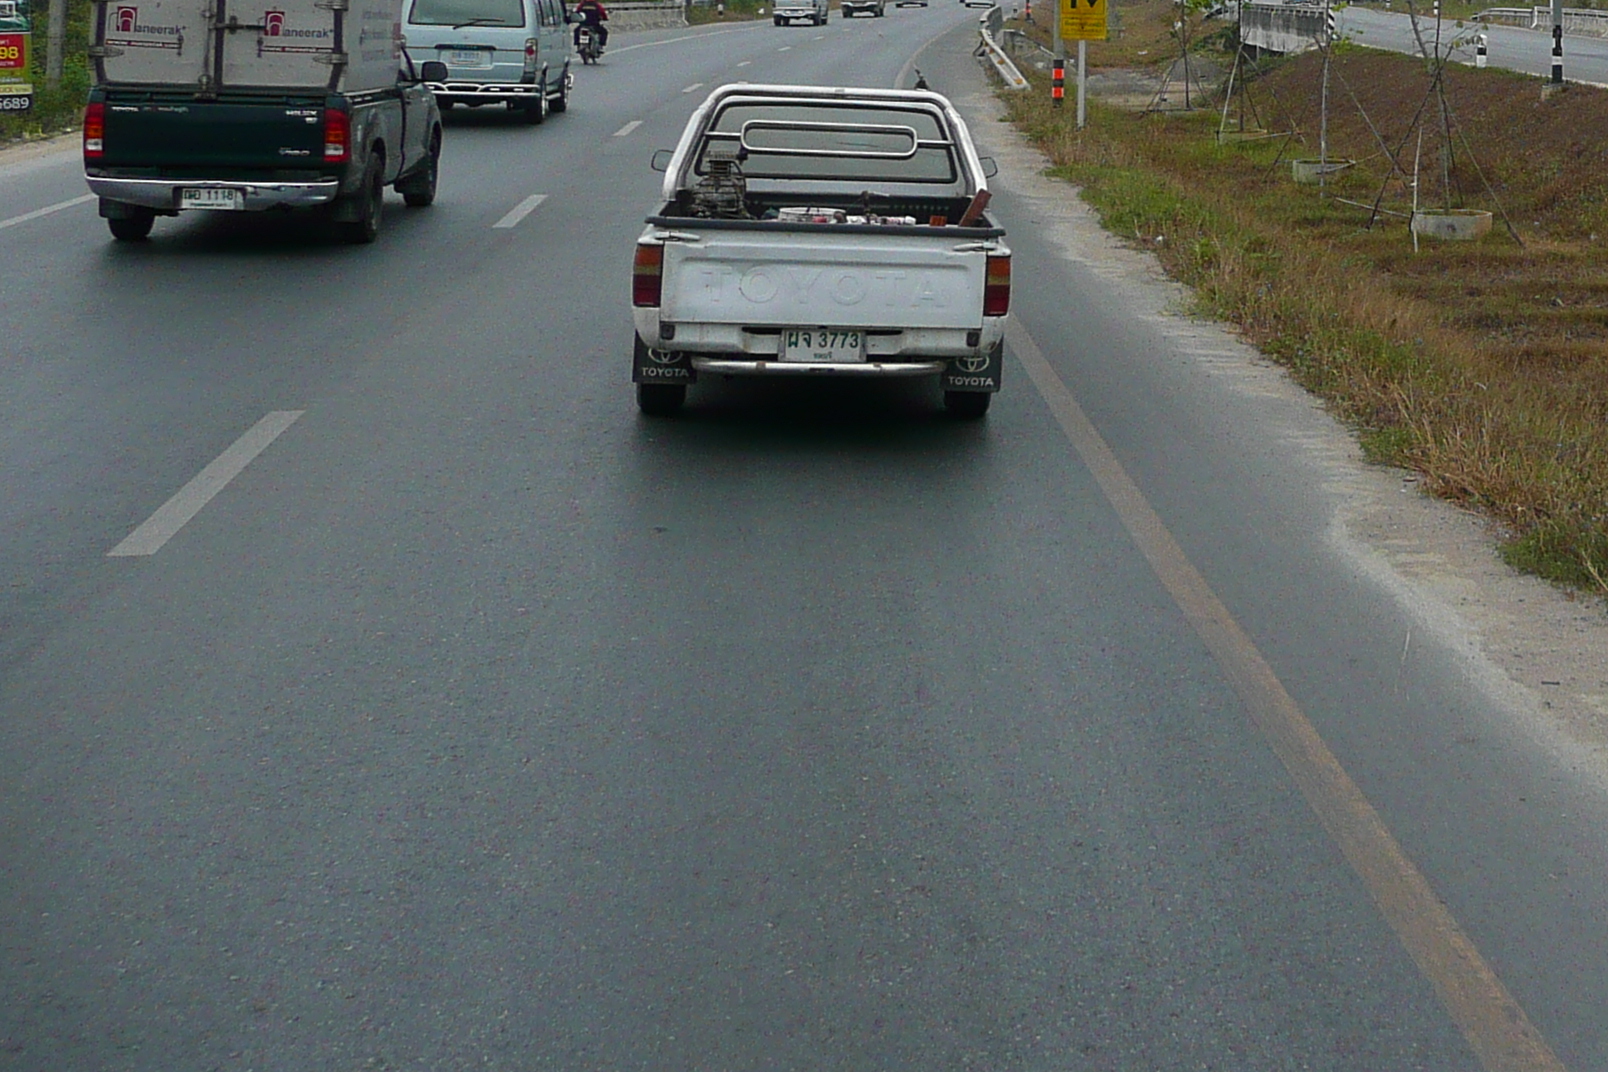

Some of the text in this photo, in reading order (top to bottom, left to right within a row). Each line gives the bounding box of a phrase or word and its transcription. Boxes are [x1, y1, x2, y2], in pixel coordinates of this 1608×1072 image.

[0, 97, 29, 109] 689
[701, 264, 947, 307] TOYOTA
[818, 331, 859, 349] 3773
[641, 367, 690, 377] TOYOTA
[948, 375, 995, 387] TOYOTA
